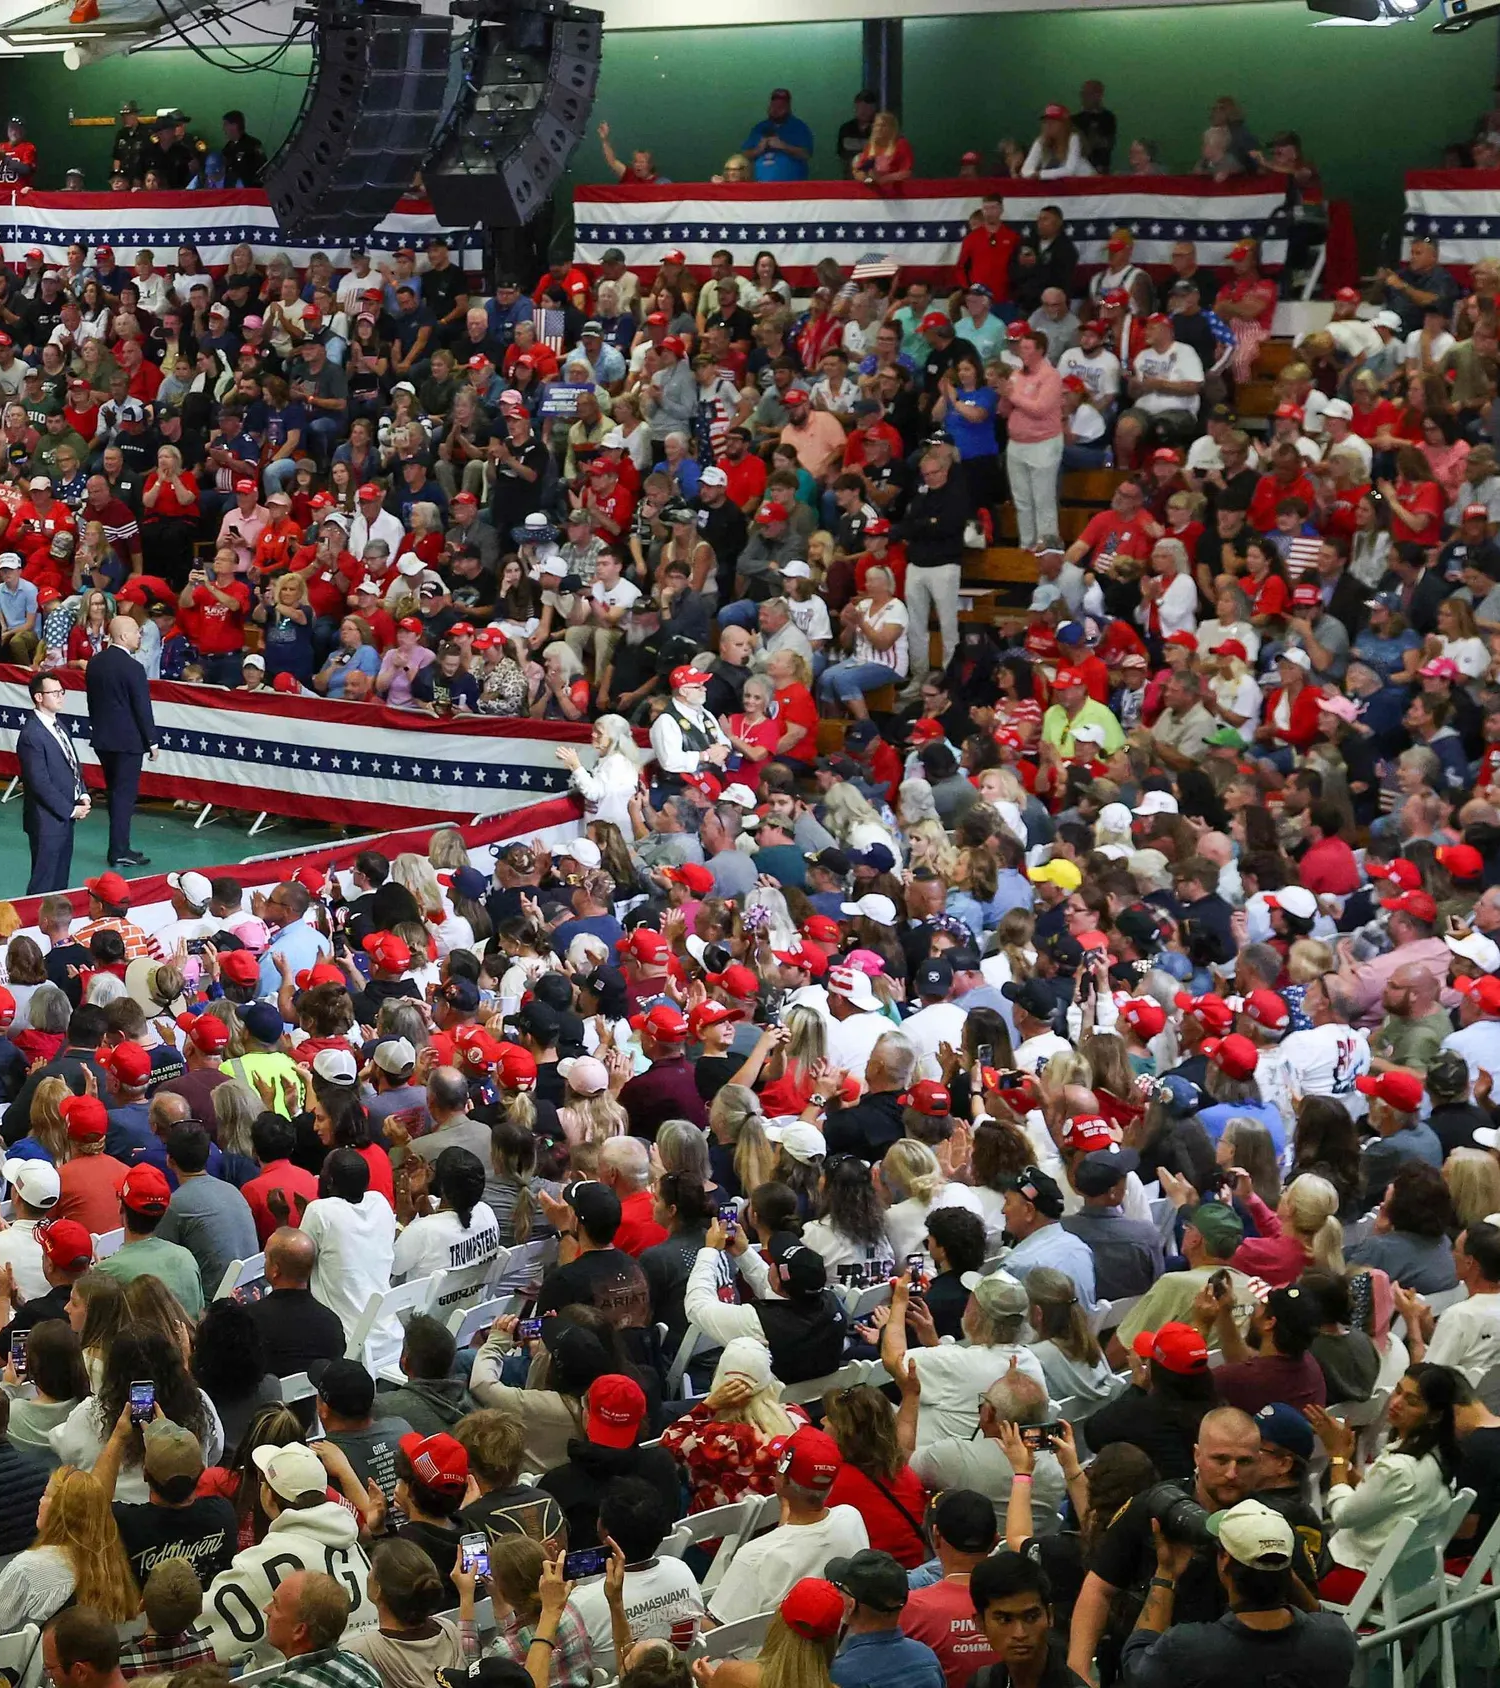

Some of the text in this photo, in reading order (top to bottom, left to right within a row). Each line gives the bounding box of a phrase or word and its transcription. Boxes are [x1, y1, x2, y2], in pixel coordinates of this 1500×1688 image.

[162, 1062, 184, 1072] AMERICA
[449, 1226, 498, 1267] TRUMPSTERS
[601, 1291, 647, 1309] ARIAT
[624, 1588, 690, 1619] RAMASWAMY
[950, 1619, 976, 1633] PIN
[953, 1643, 994, 1653] COMM
